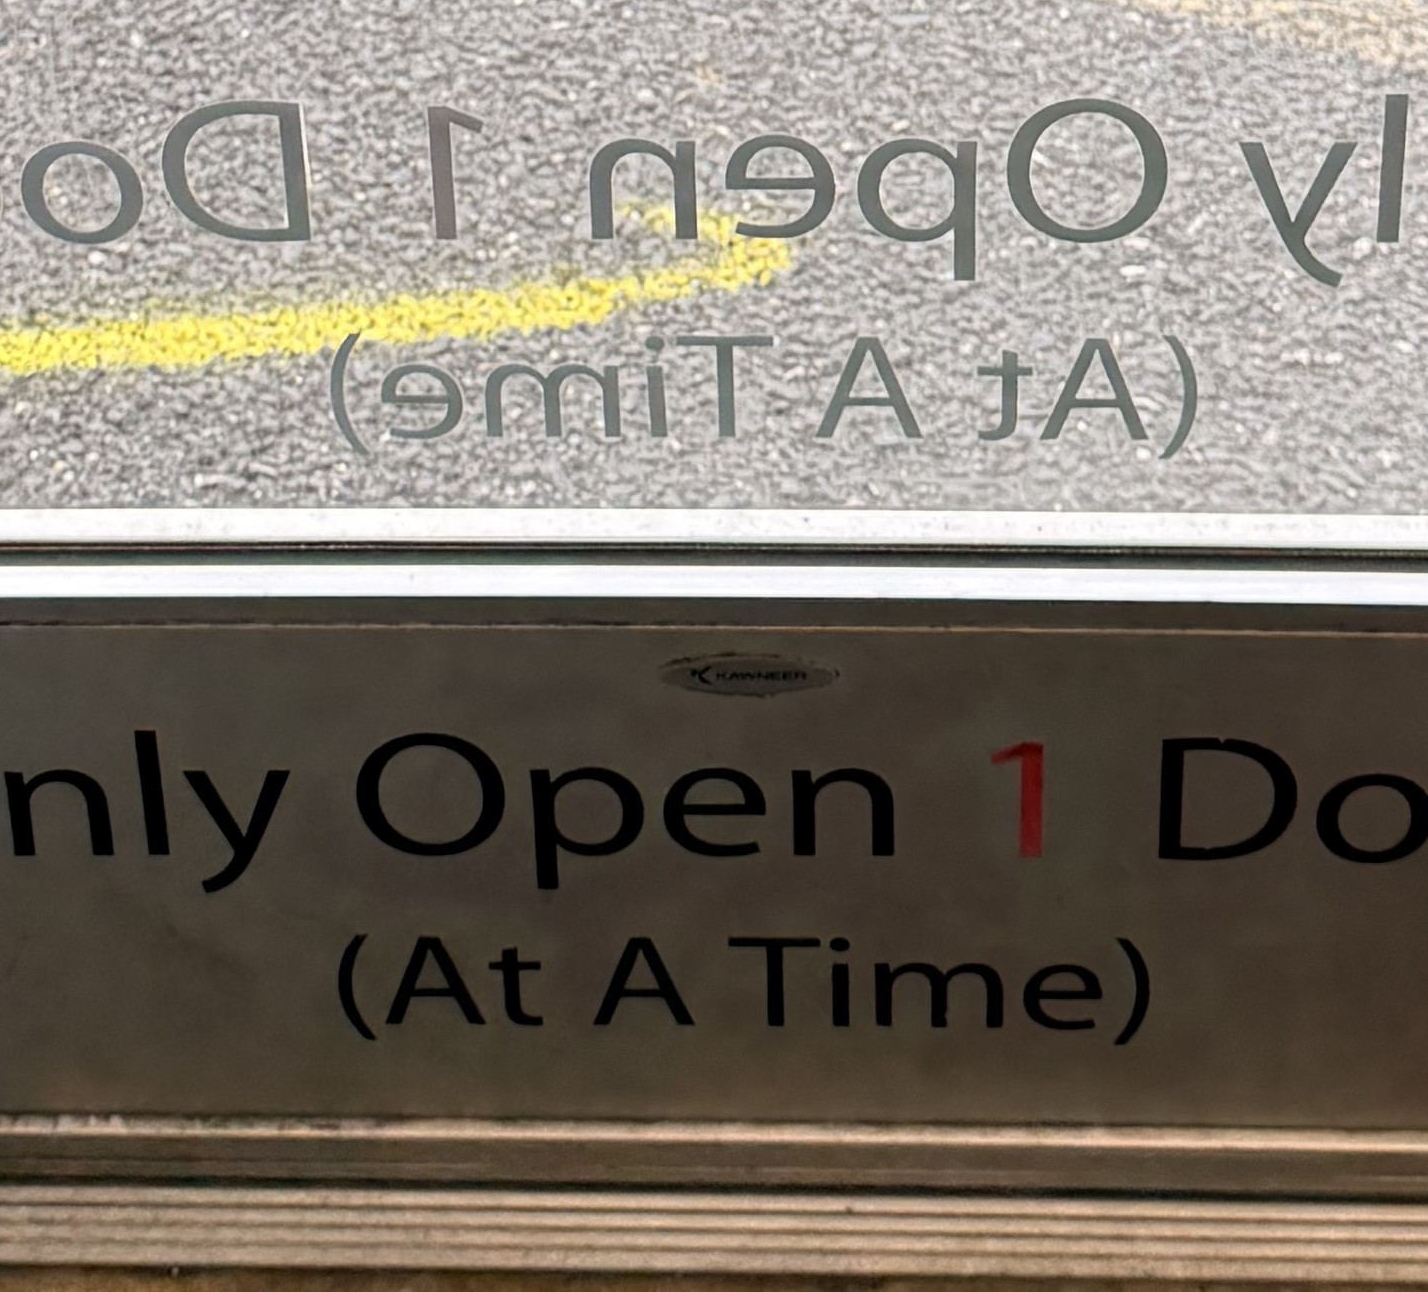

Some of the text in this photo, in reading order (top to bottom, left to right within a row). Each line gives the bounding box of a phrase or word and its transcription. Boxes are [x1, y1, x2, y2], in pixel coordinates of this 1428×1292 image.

[356, 733, 896, 895] Open
[991, 742, 1044, 855] 1
[338, 934, 1151, 1047] (At A Time)
